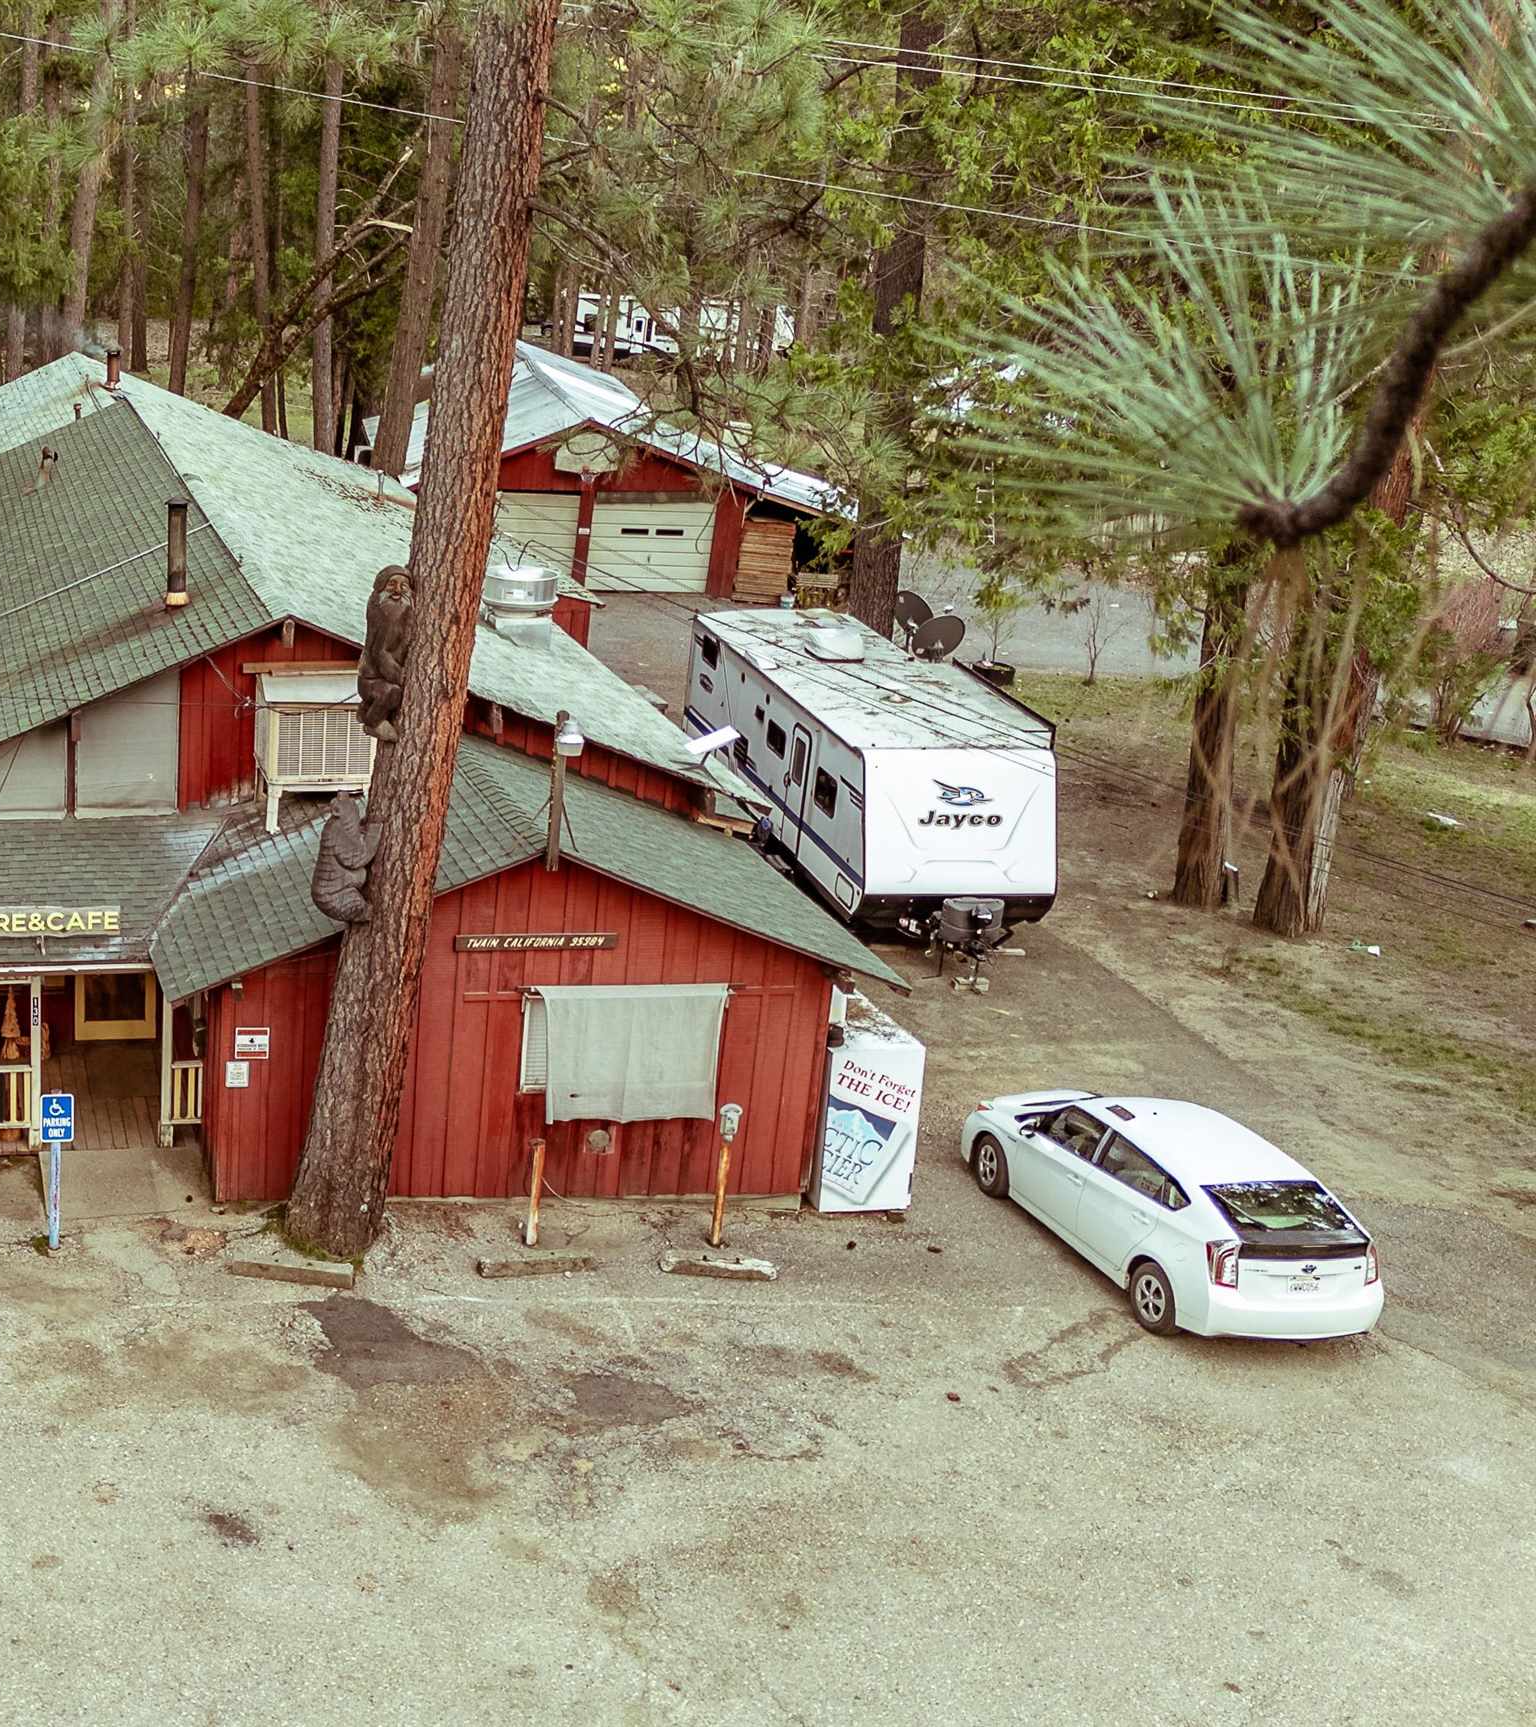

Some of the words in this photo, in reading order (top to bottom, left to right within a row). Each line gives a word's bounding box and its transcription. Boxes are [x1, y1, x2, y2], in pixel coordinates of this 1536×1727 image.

[918, 810, 1004, 830] Jayco
[466, 938, 500, 949] TWAIN
[503, 937, 565, 948] CALIFORNIA
[843, 1059, 876, 1081] Don't
[878, 1074, 916, 1098] Forget
[837, 1072, 872, 1097] THE
[874, 1090, 911, 1113] ICE!
[43, 1117, 71, 1128] PARKING
[48, 1128, 66, 1138] ONLY
